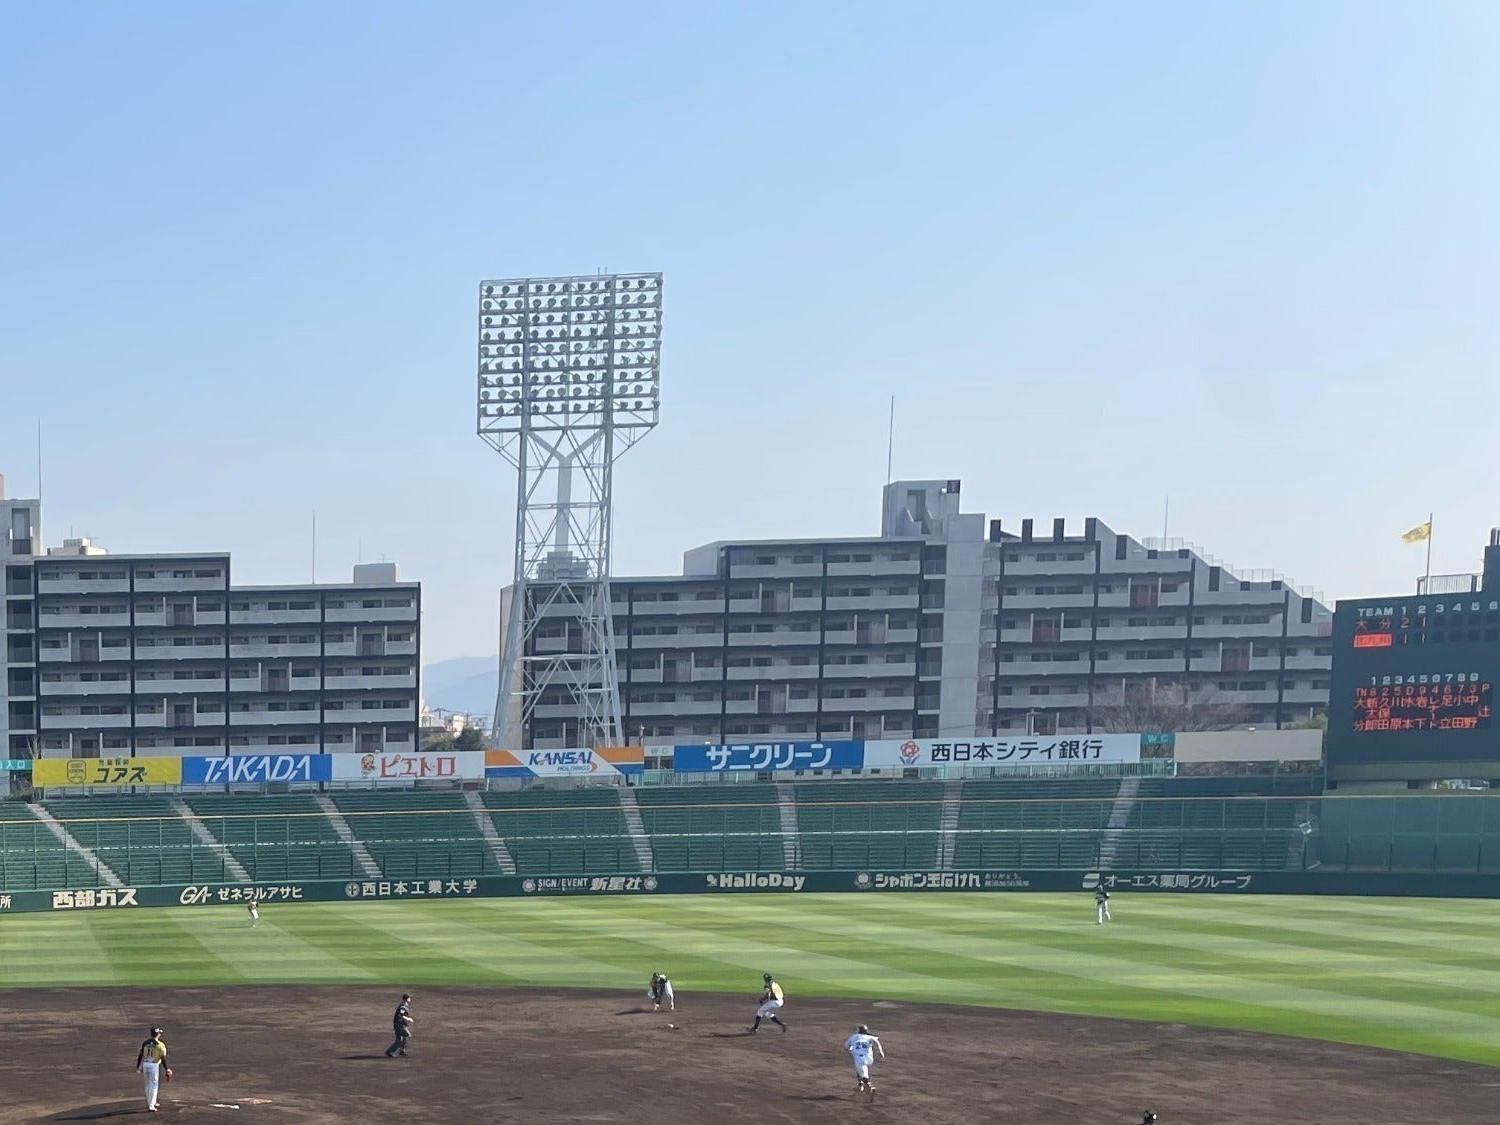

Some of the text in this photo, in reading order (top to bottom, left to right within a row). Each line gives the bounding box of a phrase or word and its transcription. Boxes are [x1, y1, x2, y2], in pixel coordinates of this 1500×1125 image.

[1358, 607, 1394, 616] TEAM
[1418, 605, 1426, 614] 2
[1436, 604, 1444, 613] 3
[1452, 603, 1461, 611] 4
[529, 751, 593, 765] KANSAI
[706, 743, 832, 770] サニクリーン
[931, 740, 1103, 762] 西日本シティ銀行
[203, 755, 311, 783] TAKADA
[380, 754, 457, 778] ピエトロ
[362, 879, 478, 897] 西日本工業大学
[590, 876, 643, 891] 新星社
[720, 873, 806, 890] HalloDay
[1104, 874, 1252, 889] オーエス薬局グループ
[53, 888, 139, 908] 西部ガス
[217, 886, 303, 902] ゼネラルアサヒ
